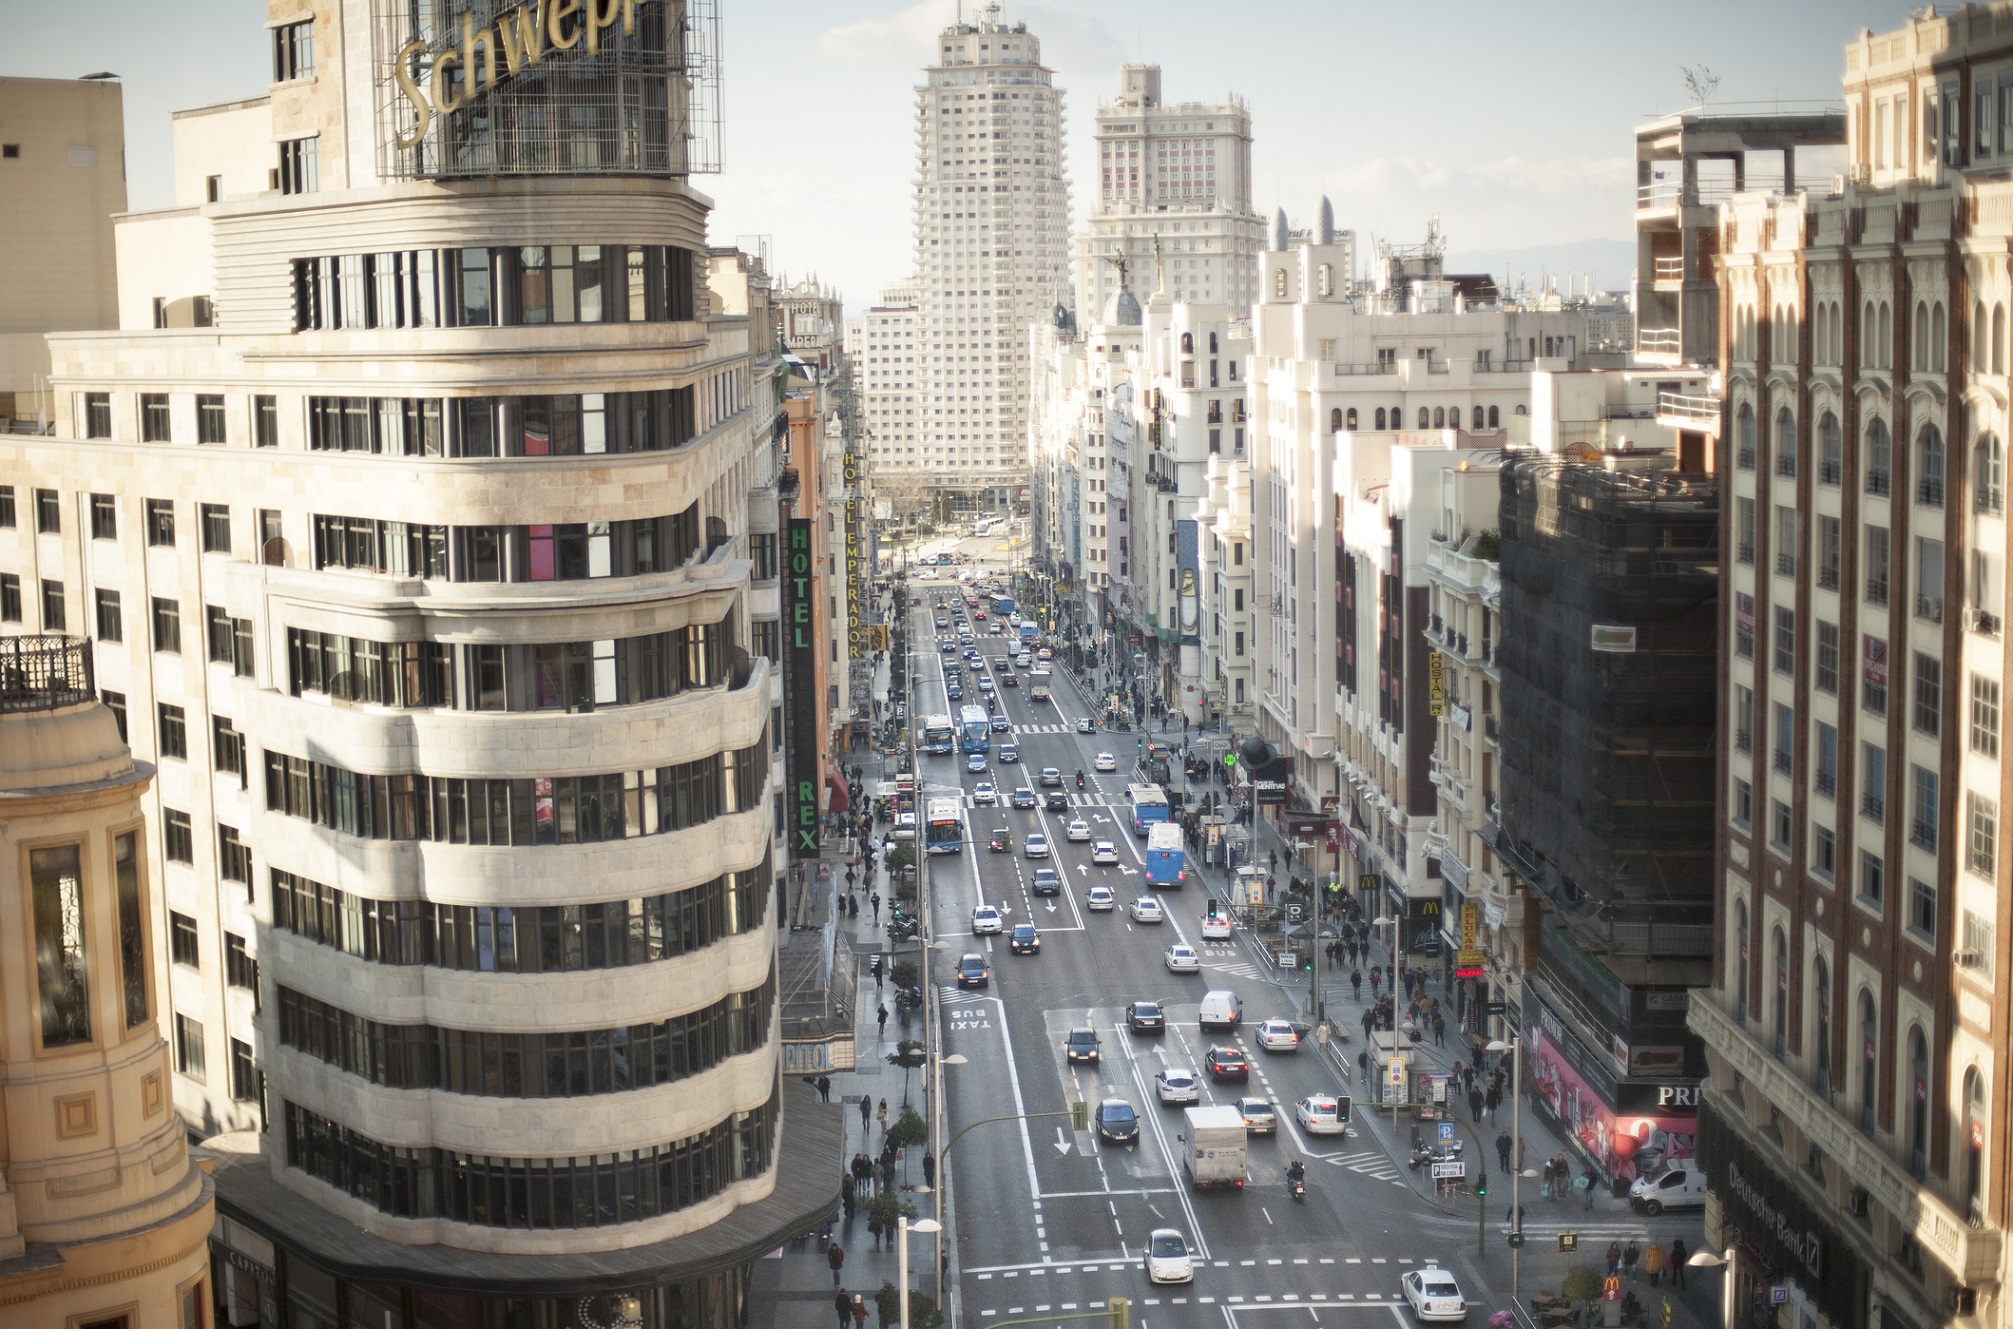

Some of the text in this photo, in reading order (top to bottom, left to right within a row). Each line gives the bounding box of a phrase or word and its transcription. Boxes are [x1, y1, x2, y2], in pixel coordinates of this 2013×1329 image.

[1072, 474, 1080, 522] SENATOR
[844, 453, 861, 658] HOTEL EMPERADOR
[791, 528, 818, 850] HOTEL REX
[1431, 653, 1442, 700] HOSTAL
[1199, 940, 1238, 948] TAXI
[1463, 906, 1474, 951] PELUCAS
[1204, 949, 1237, 957] BUS
[950, 1020, 991, 1030] TAXI
[951, 1009, 986, 1019] BUS
[1729, 1161, 1777, 1231] Deutsche
[1776, 1211, 1807, 1264] Bank
